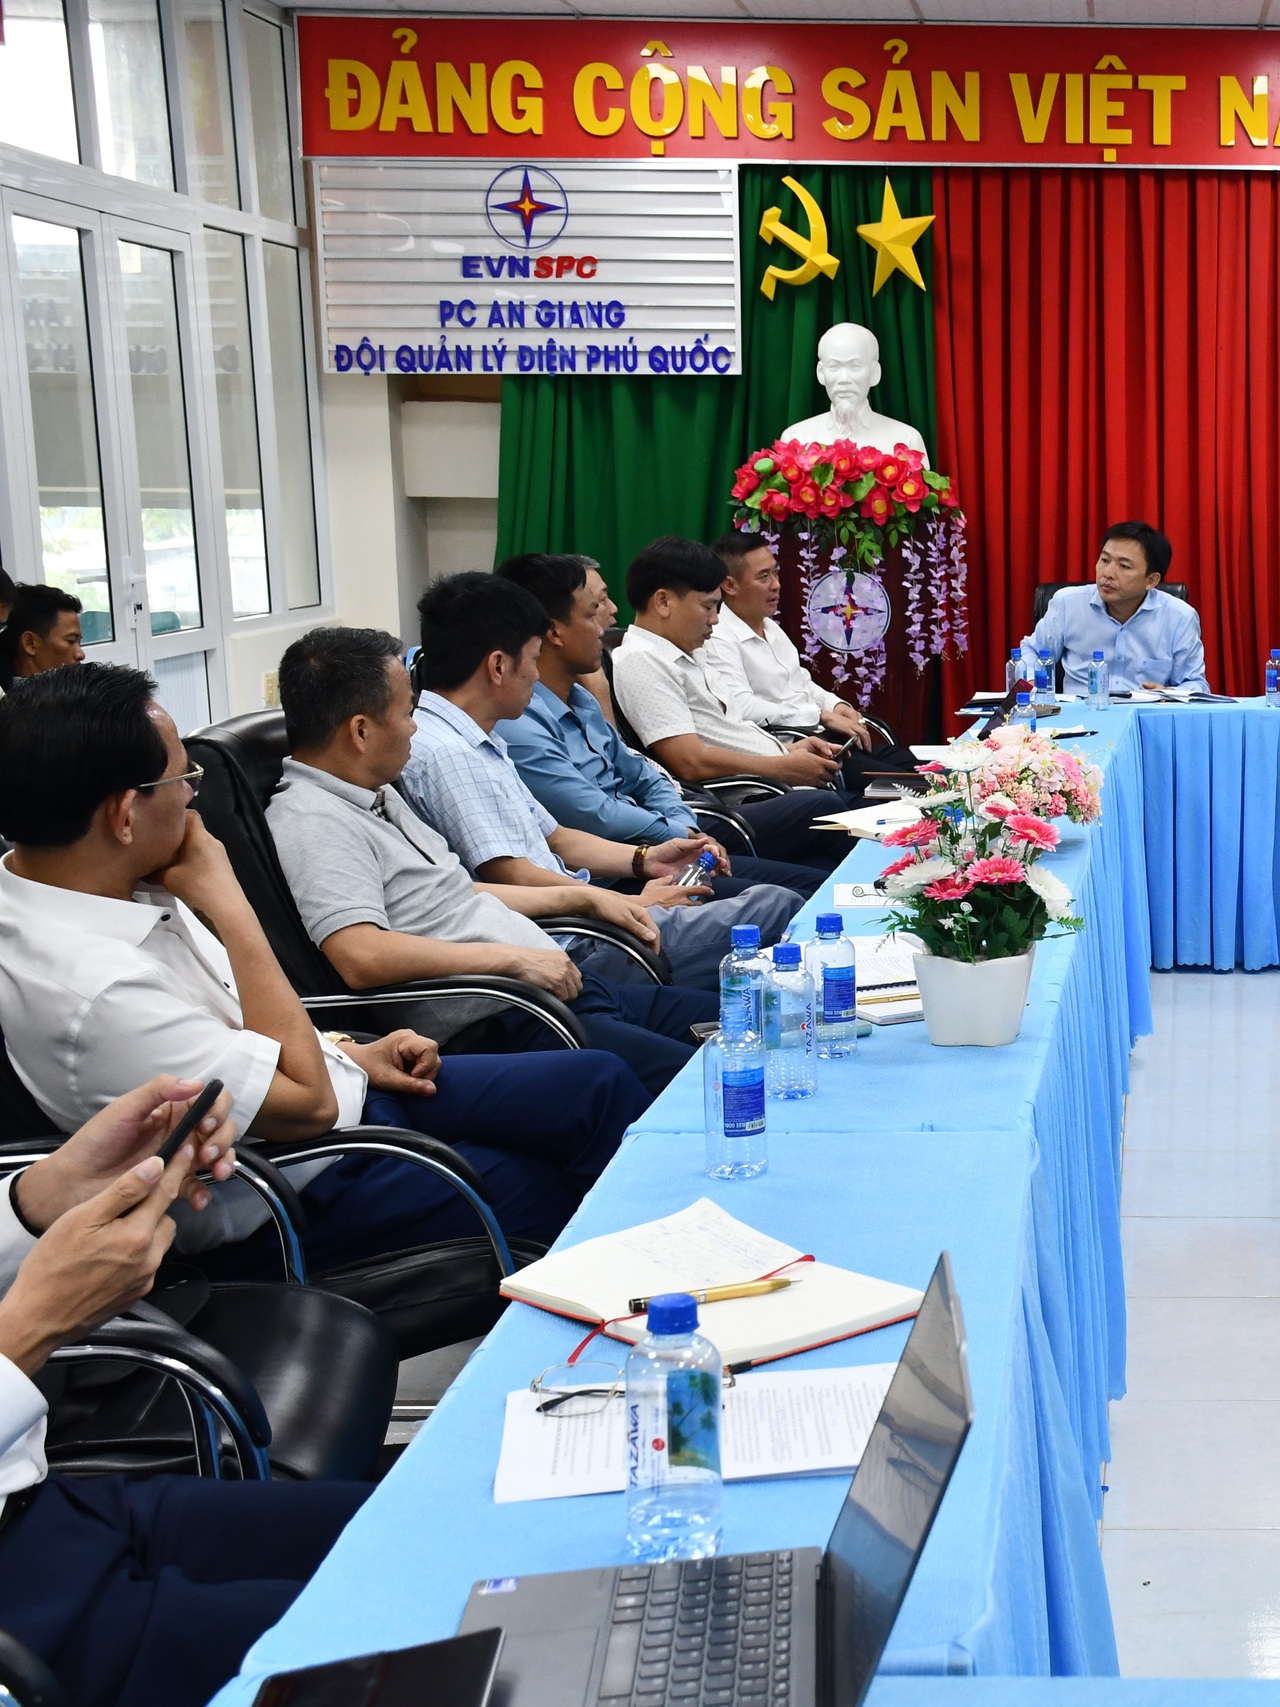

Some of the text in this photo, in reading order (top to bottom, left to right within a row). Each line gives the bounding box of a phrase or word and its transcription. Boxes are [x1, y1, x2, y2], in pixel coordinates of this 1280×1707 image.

[325, 28, 543, 135] ĐẢNG
[573, 41, 795, 155] CỘNG
[822, 38, 980, 142] SẢN
[1009, 54, 1187, 163] VIỆT
[439, 300, 626, 328] PC AN GIANG
[334, 332, 732, 377] ĐỘI QUẢN LÝ ĐIỆN PHÚ QUỐC
[805, 1002, 813, 1056] TAZAWA
[629, 1403, 639, 1488] TAZAWA
